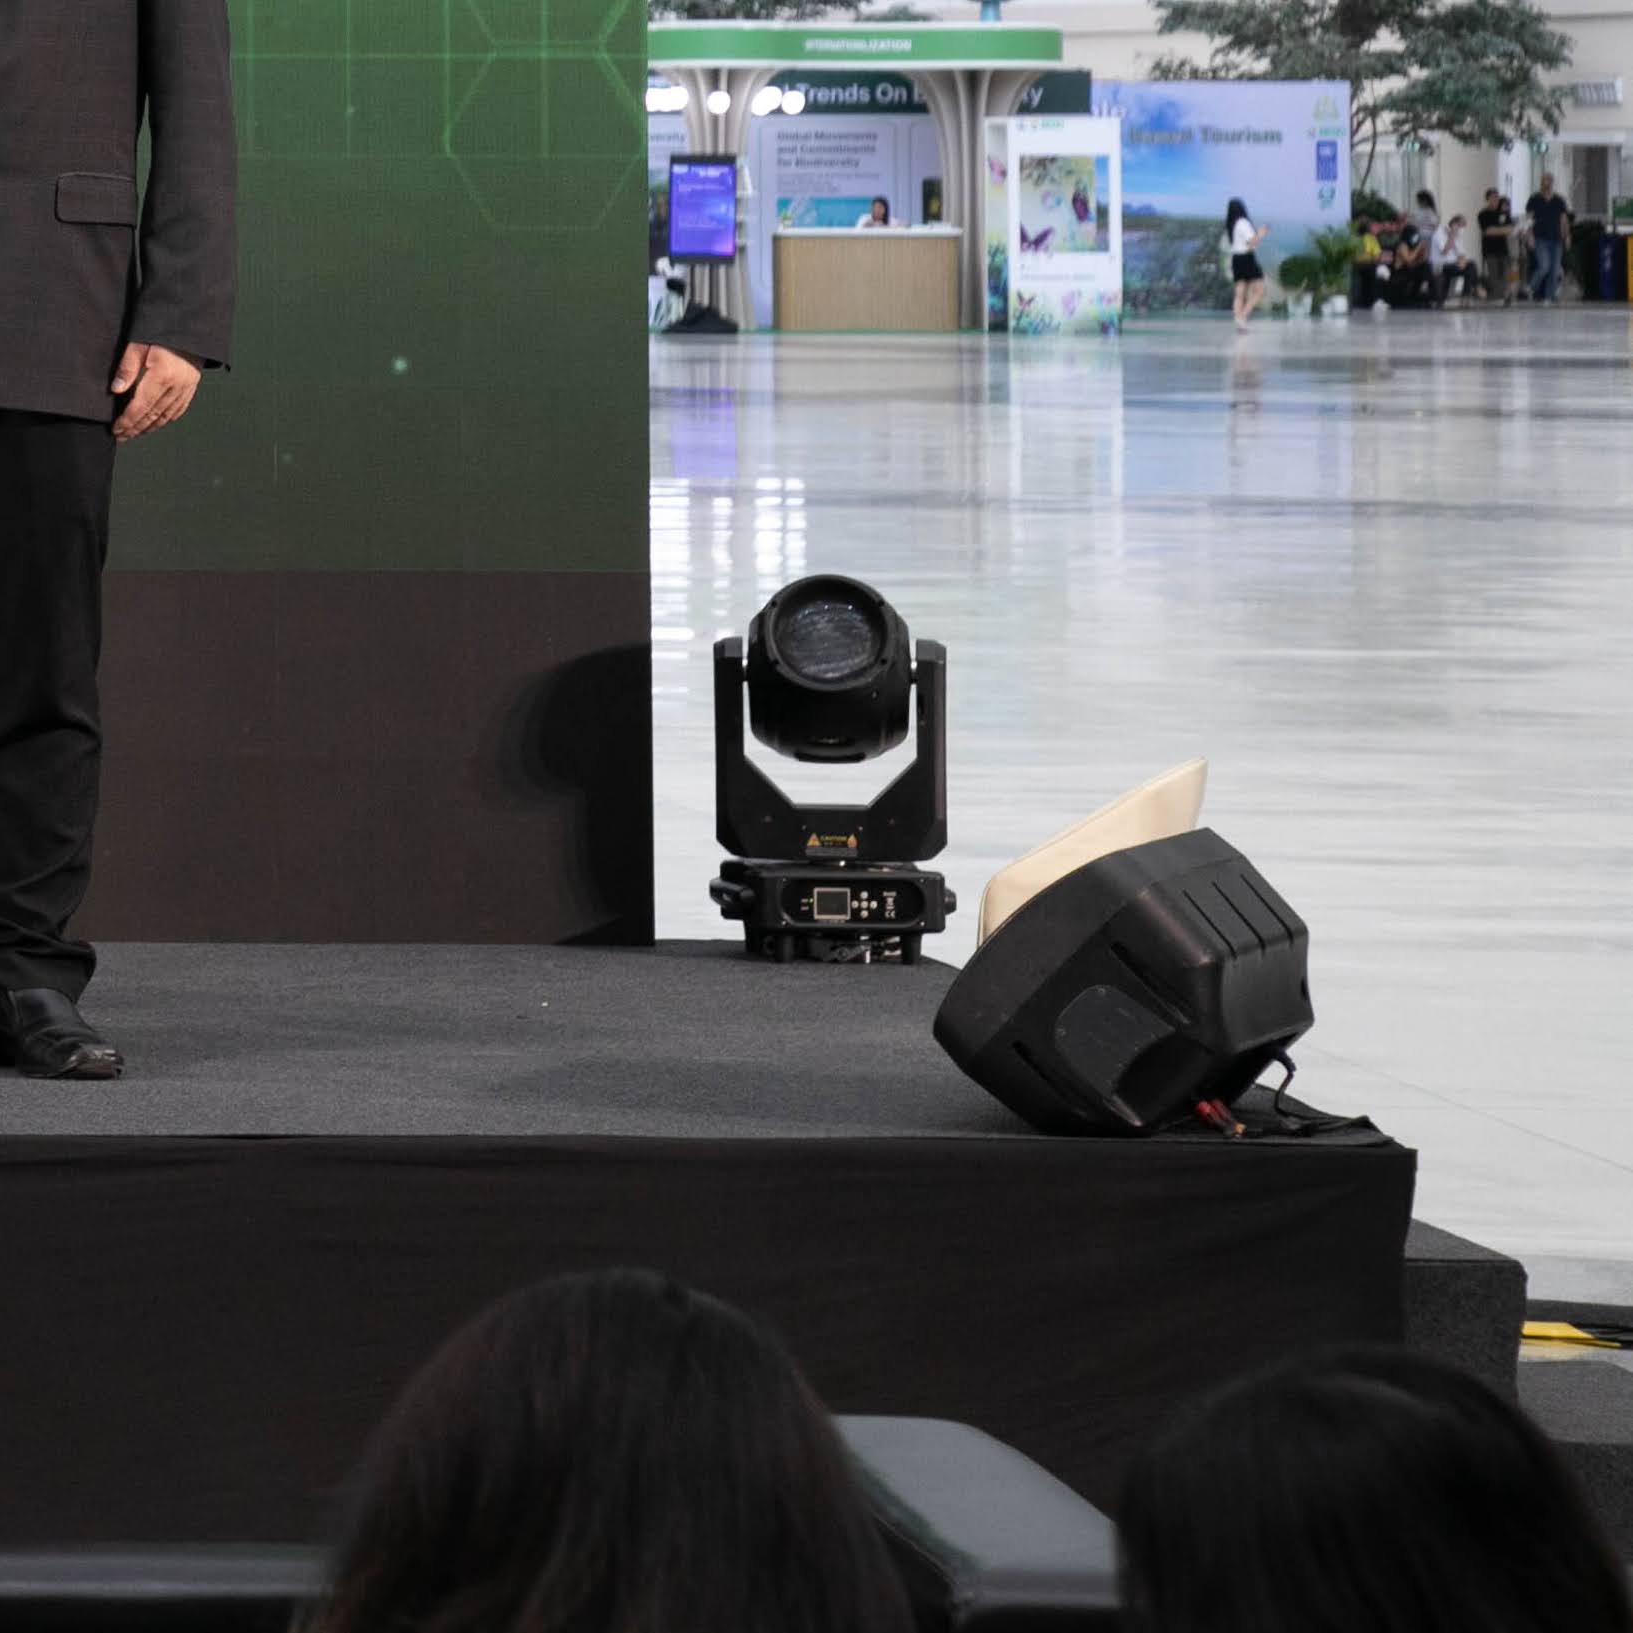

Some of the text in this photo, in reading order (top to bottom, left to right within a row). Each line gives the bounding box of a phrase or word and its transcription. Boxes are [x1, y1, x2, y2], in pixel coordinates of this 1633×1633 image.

[796, 81, 871, 106] Trends
[875, 81, 908, 105] On
[1199, 125, 1283, 145] Tourism
